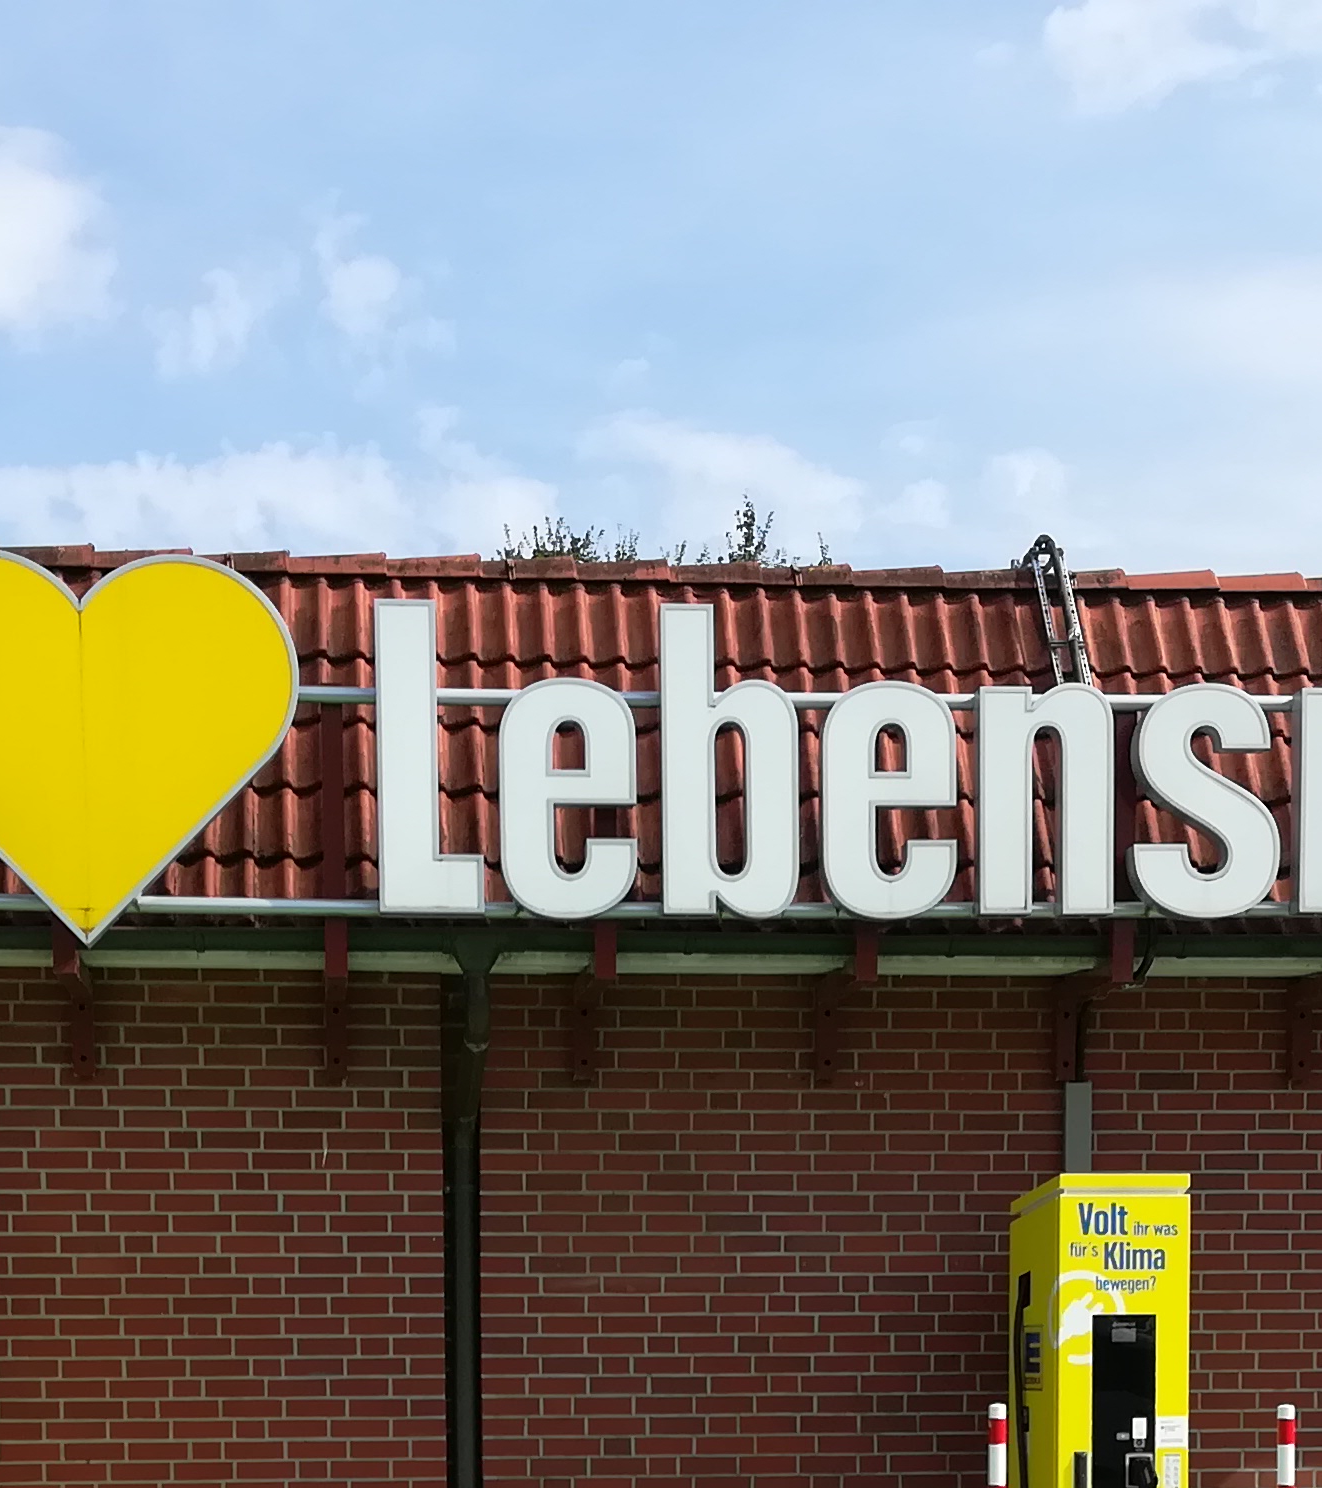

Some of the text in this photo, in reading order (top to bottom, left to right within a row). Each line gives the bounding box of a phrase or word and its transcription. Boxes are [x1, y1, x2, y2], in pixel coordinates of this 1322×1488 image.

[1078, 1202, 1179, 1236] Volt ihr was
[1104, 1241, 1166, 1270] Klima
[1095, 1275, 1157, 1294] bewegen?
